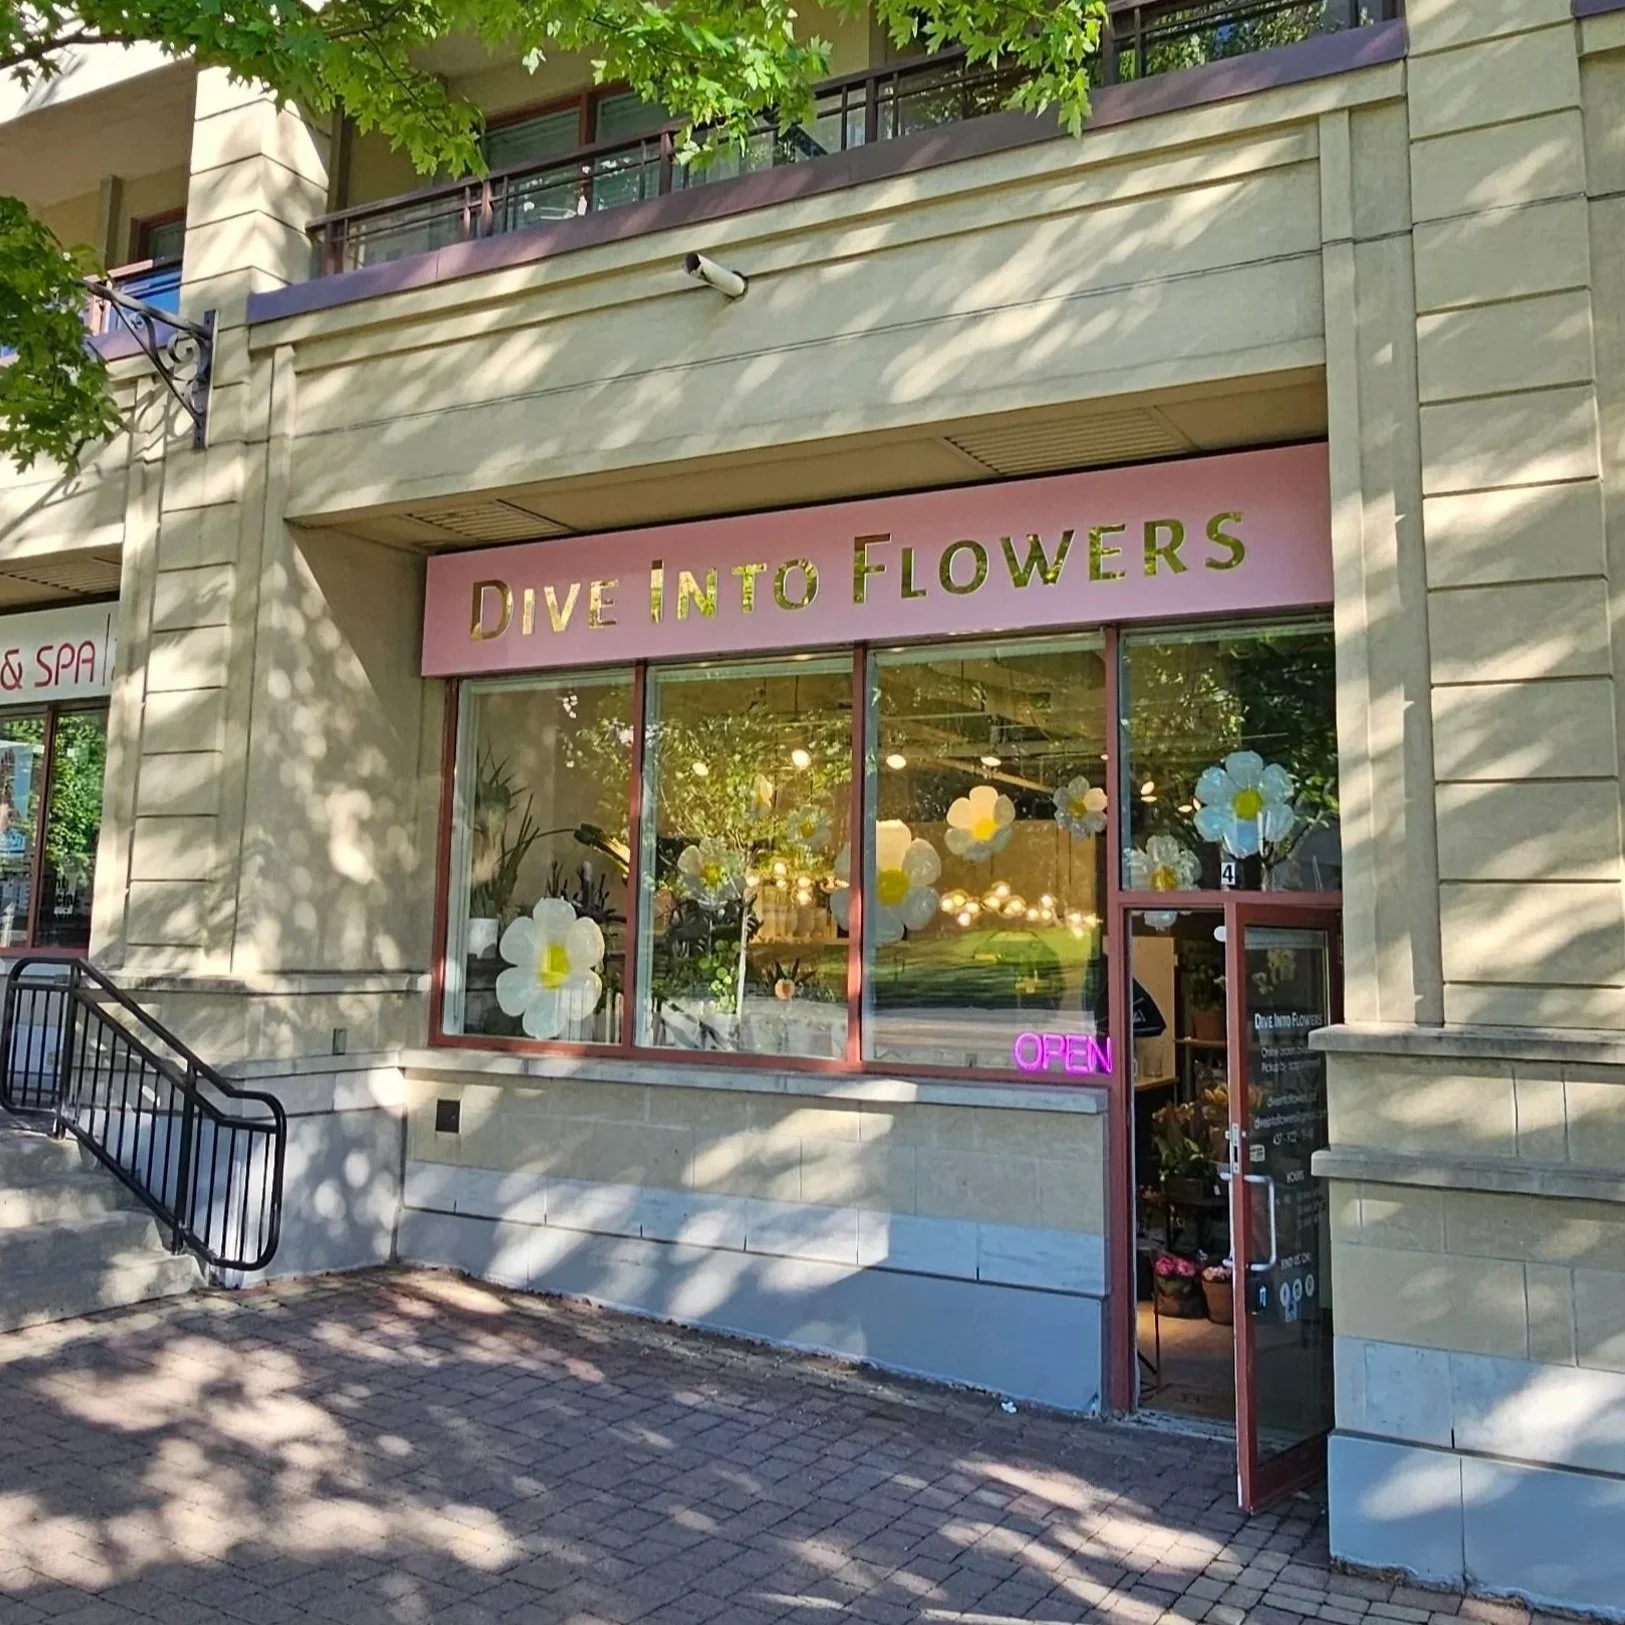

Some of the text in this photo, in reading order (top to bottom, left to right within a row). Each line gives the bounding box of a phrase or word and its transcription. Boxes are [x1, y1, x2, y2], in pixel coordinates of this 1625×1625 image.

[469, 511, 1246, 641] DIVE INTO FLOWERS
[0, 640, 96, 691] & SPA
[1222, 864, 1233, 883] 4
[1014, 1032, 1113, 1074] OPEN
